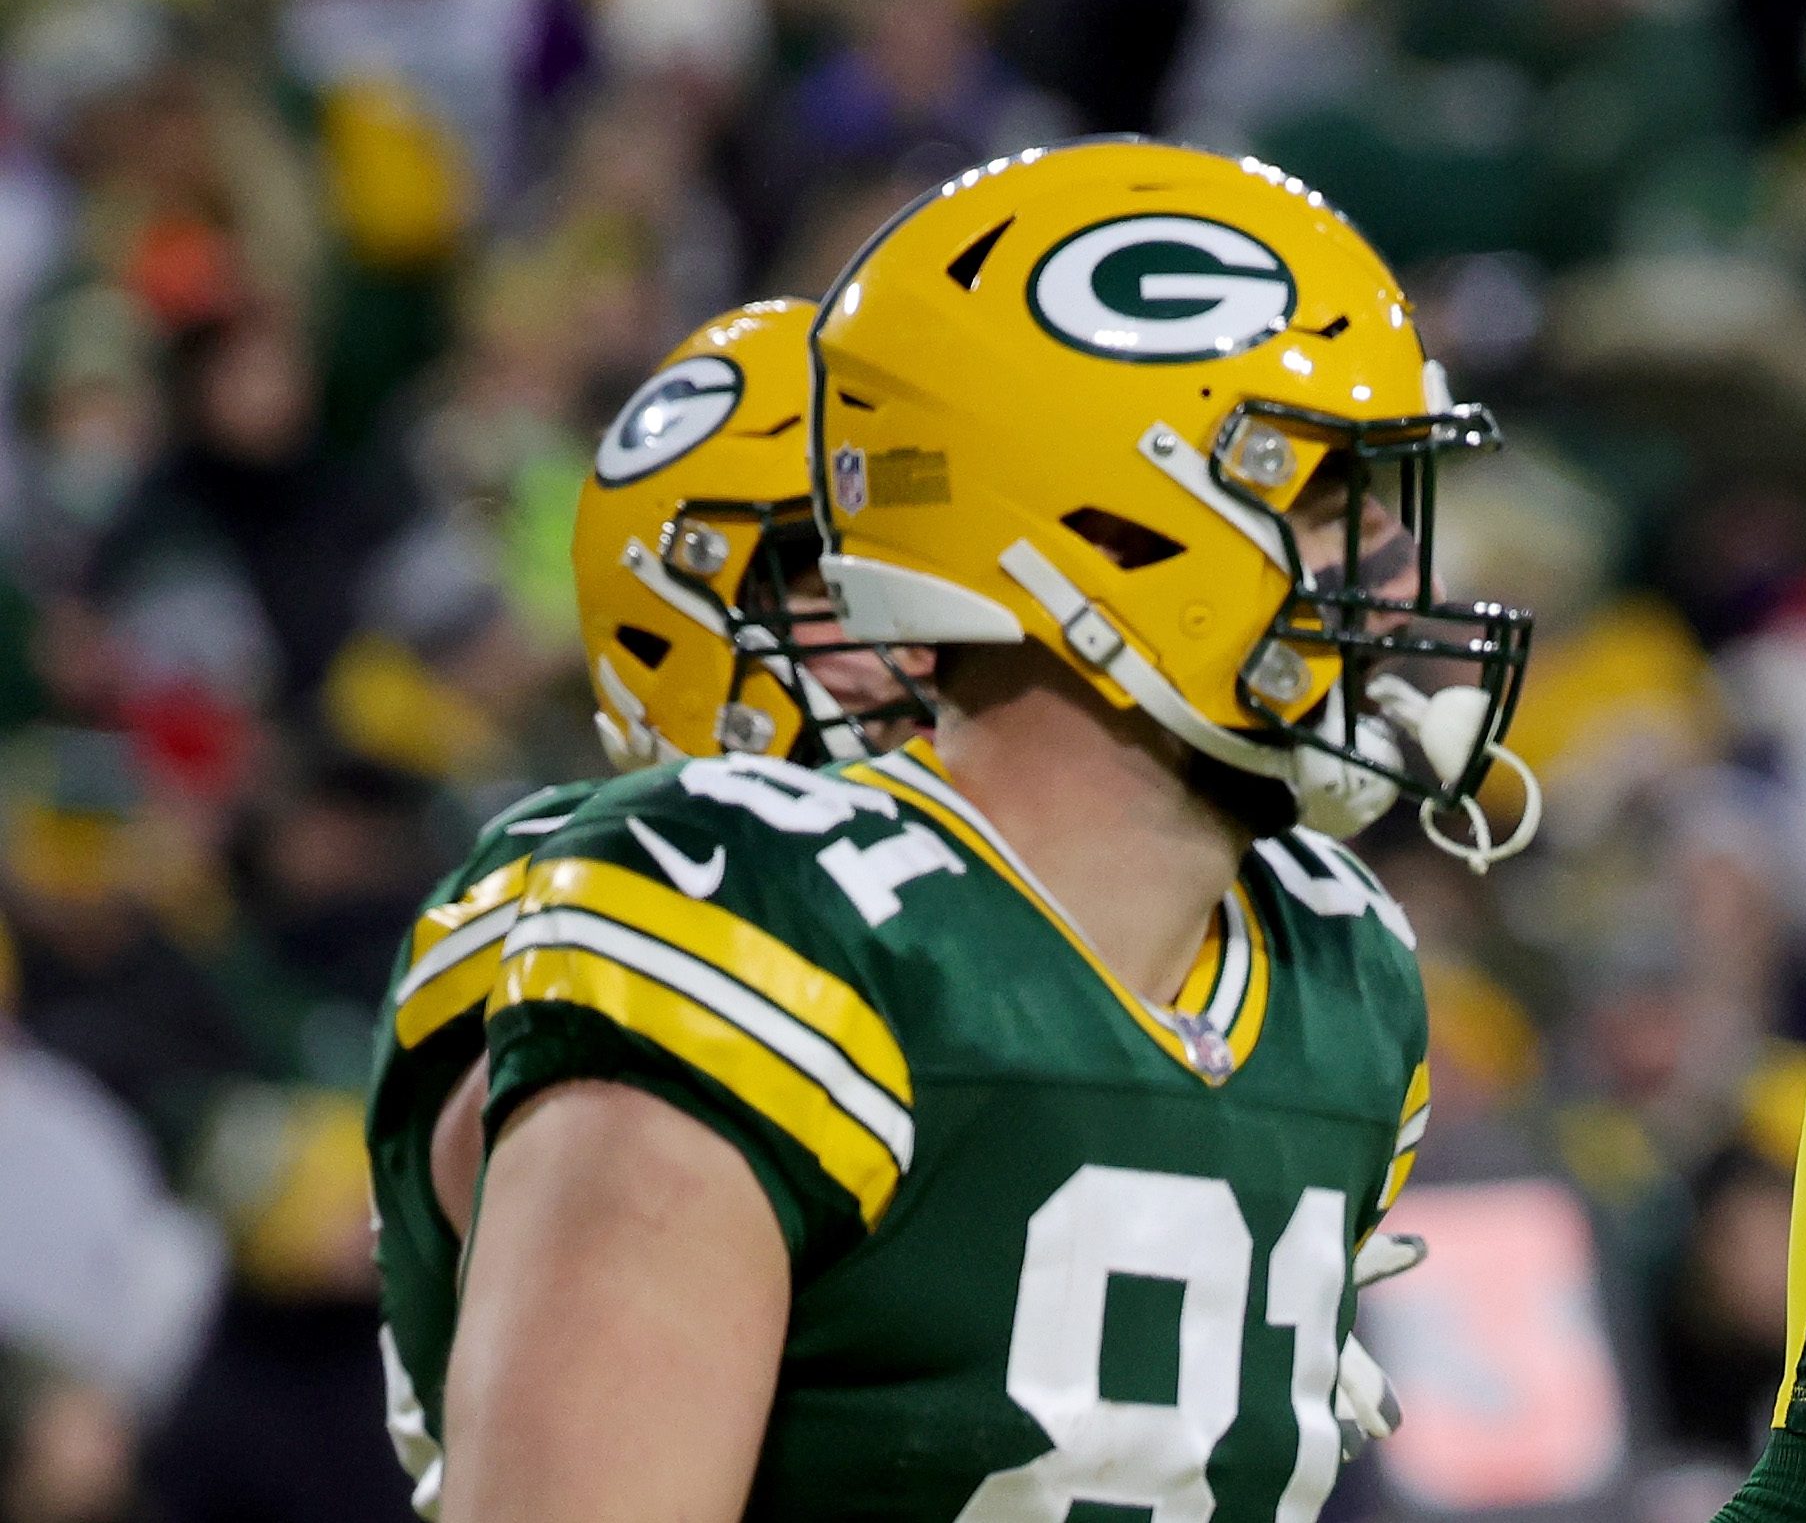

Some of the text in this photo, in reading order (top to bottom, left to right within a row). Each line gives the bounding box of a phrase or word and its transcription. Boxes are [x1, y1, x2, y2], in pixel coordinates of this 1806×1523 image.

[1036, 216, 1289, 353] G
[596, 356, 739, 481] G
[951, 1163, 1347, 1523] 81
